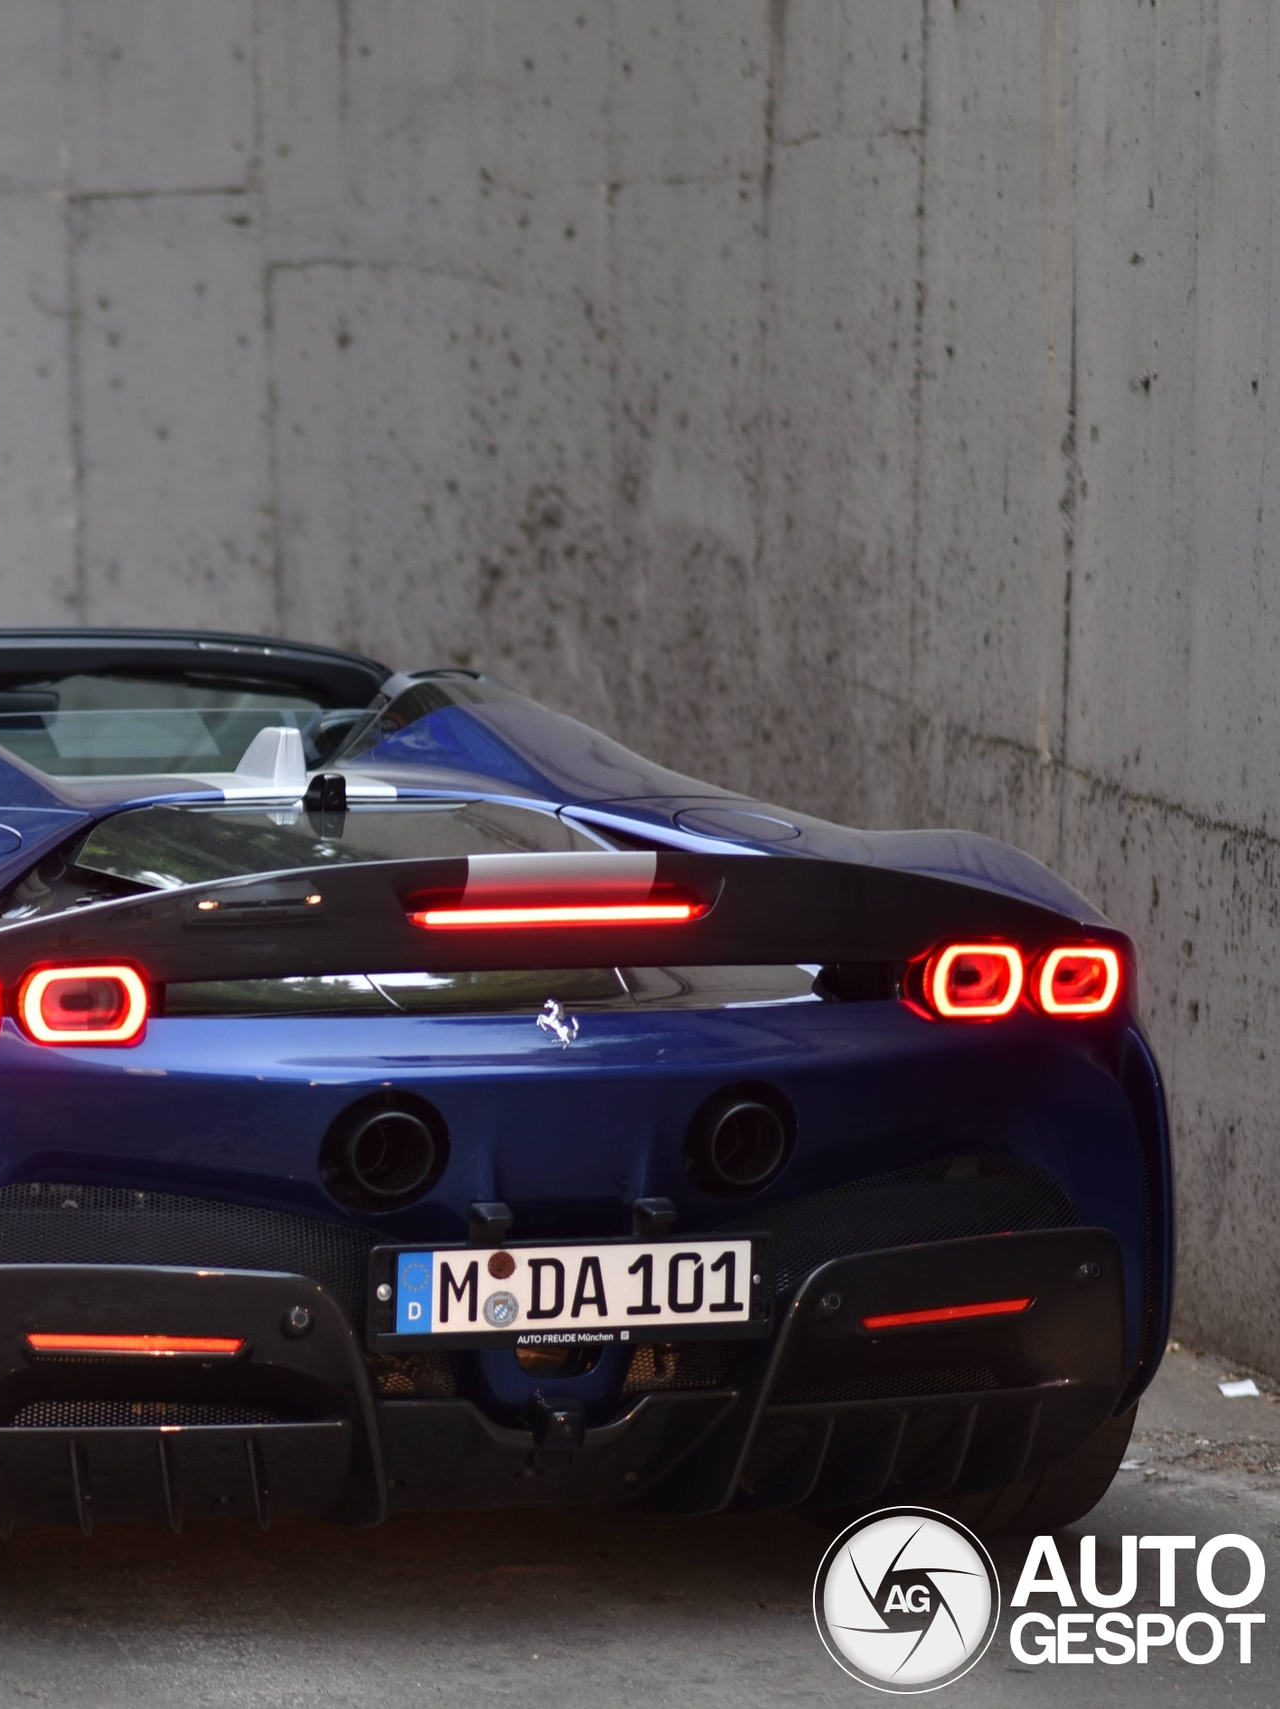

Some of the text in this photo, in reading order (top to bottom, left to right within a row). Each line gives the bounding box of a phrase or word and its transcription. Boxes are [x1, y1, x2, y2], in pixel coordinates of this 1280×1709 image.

[439, 1260, 479, 1323] M
[526, 1256, 608, 1320] DA
[626, 1251, 744, 1316] 101
[407, 1301, 422, 1320] D
[517, 1332, 614, 1344] AUTO FREUDE München
